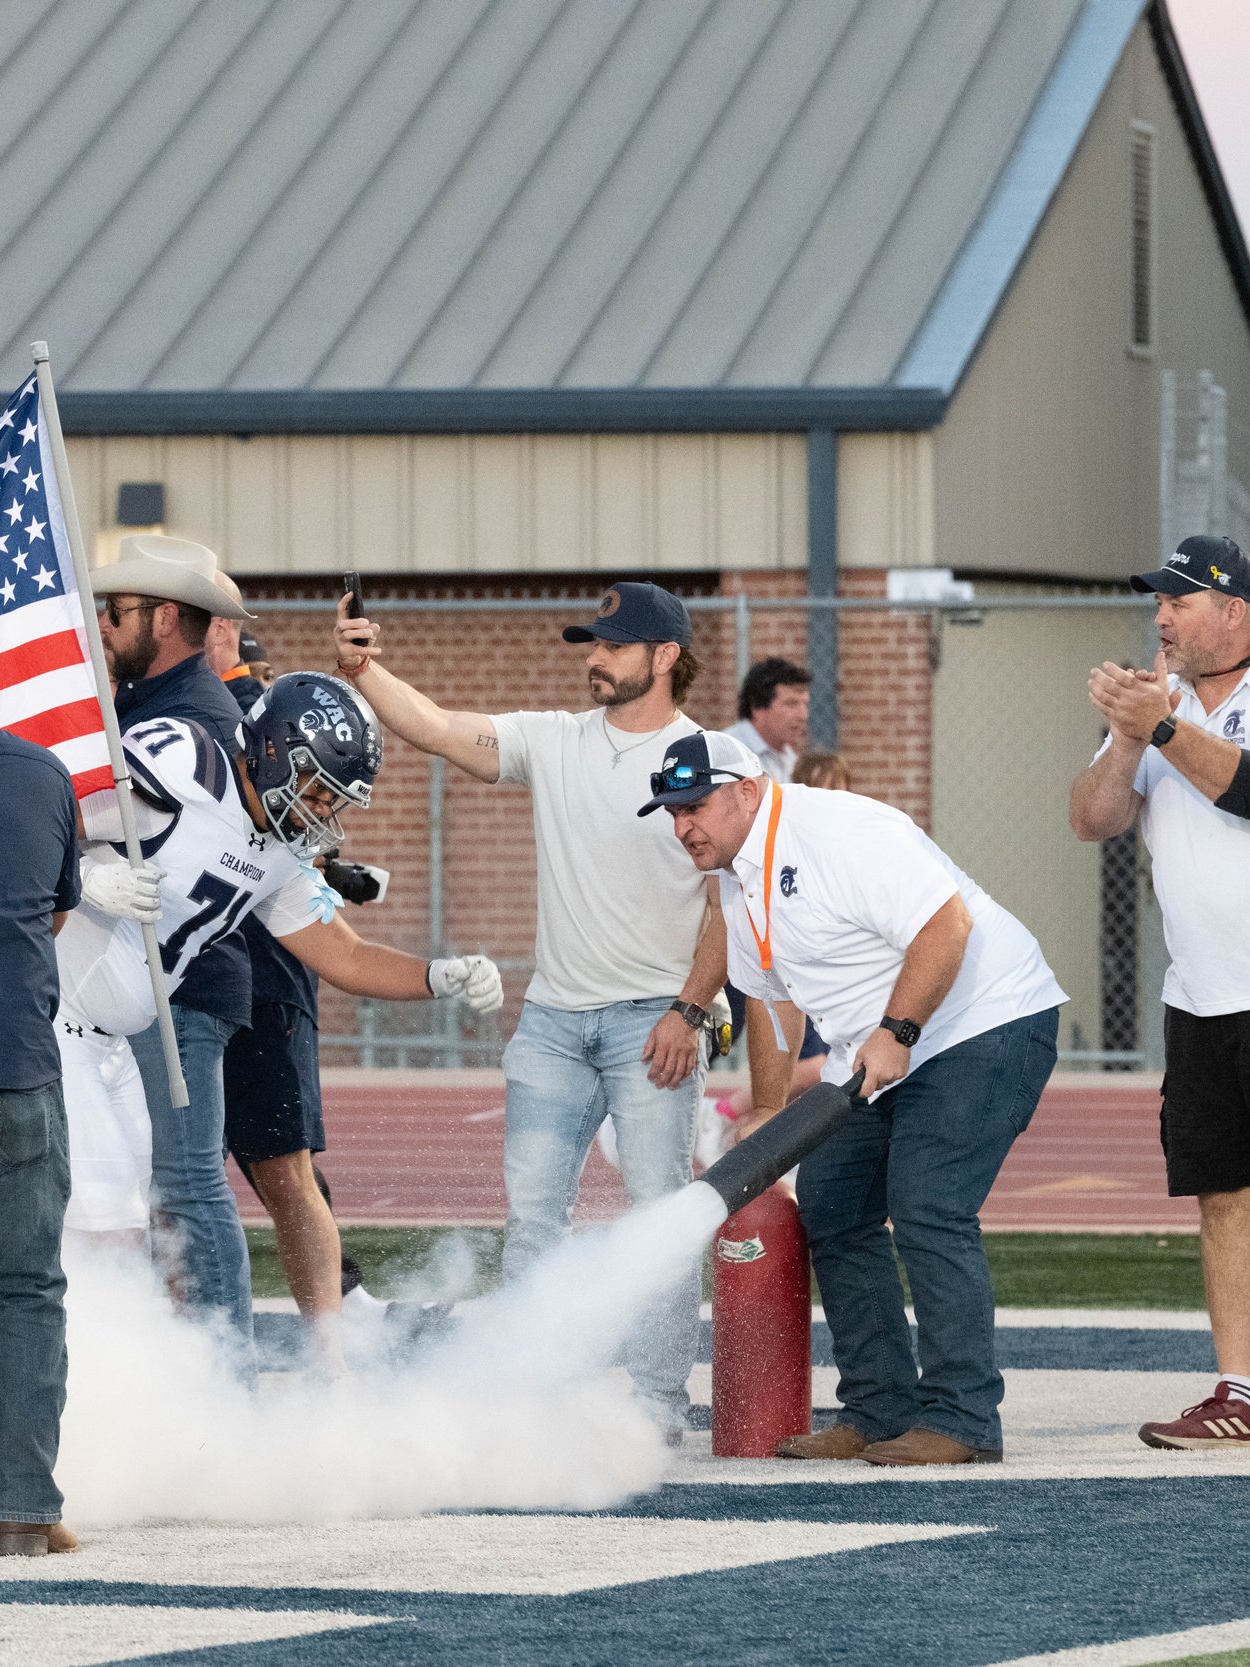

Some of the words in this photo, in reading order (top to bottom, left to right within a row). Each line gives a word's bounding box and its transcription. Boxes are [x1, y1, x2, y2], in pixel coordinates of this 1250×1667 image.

[312, 686, 353, 742] WAC
[130, 721, 186, 759] 71
[220, 851, 266, 883] CHAMPION
